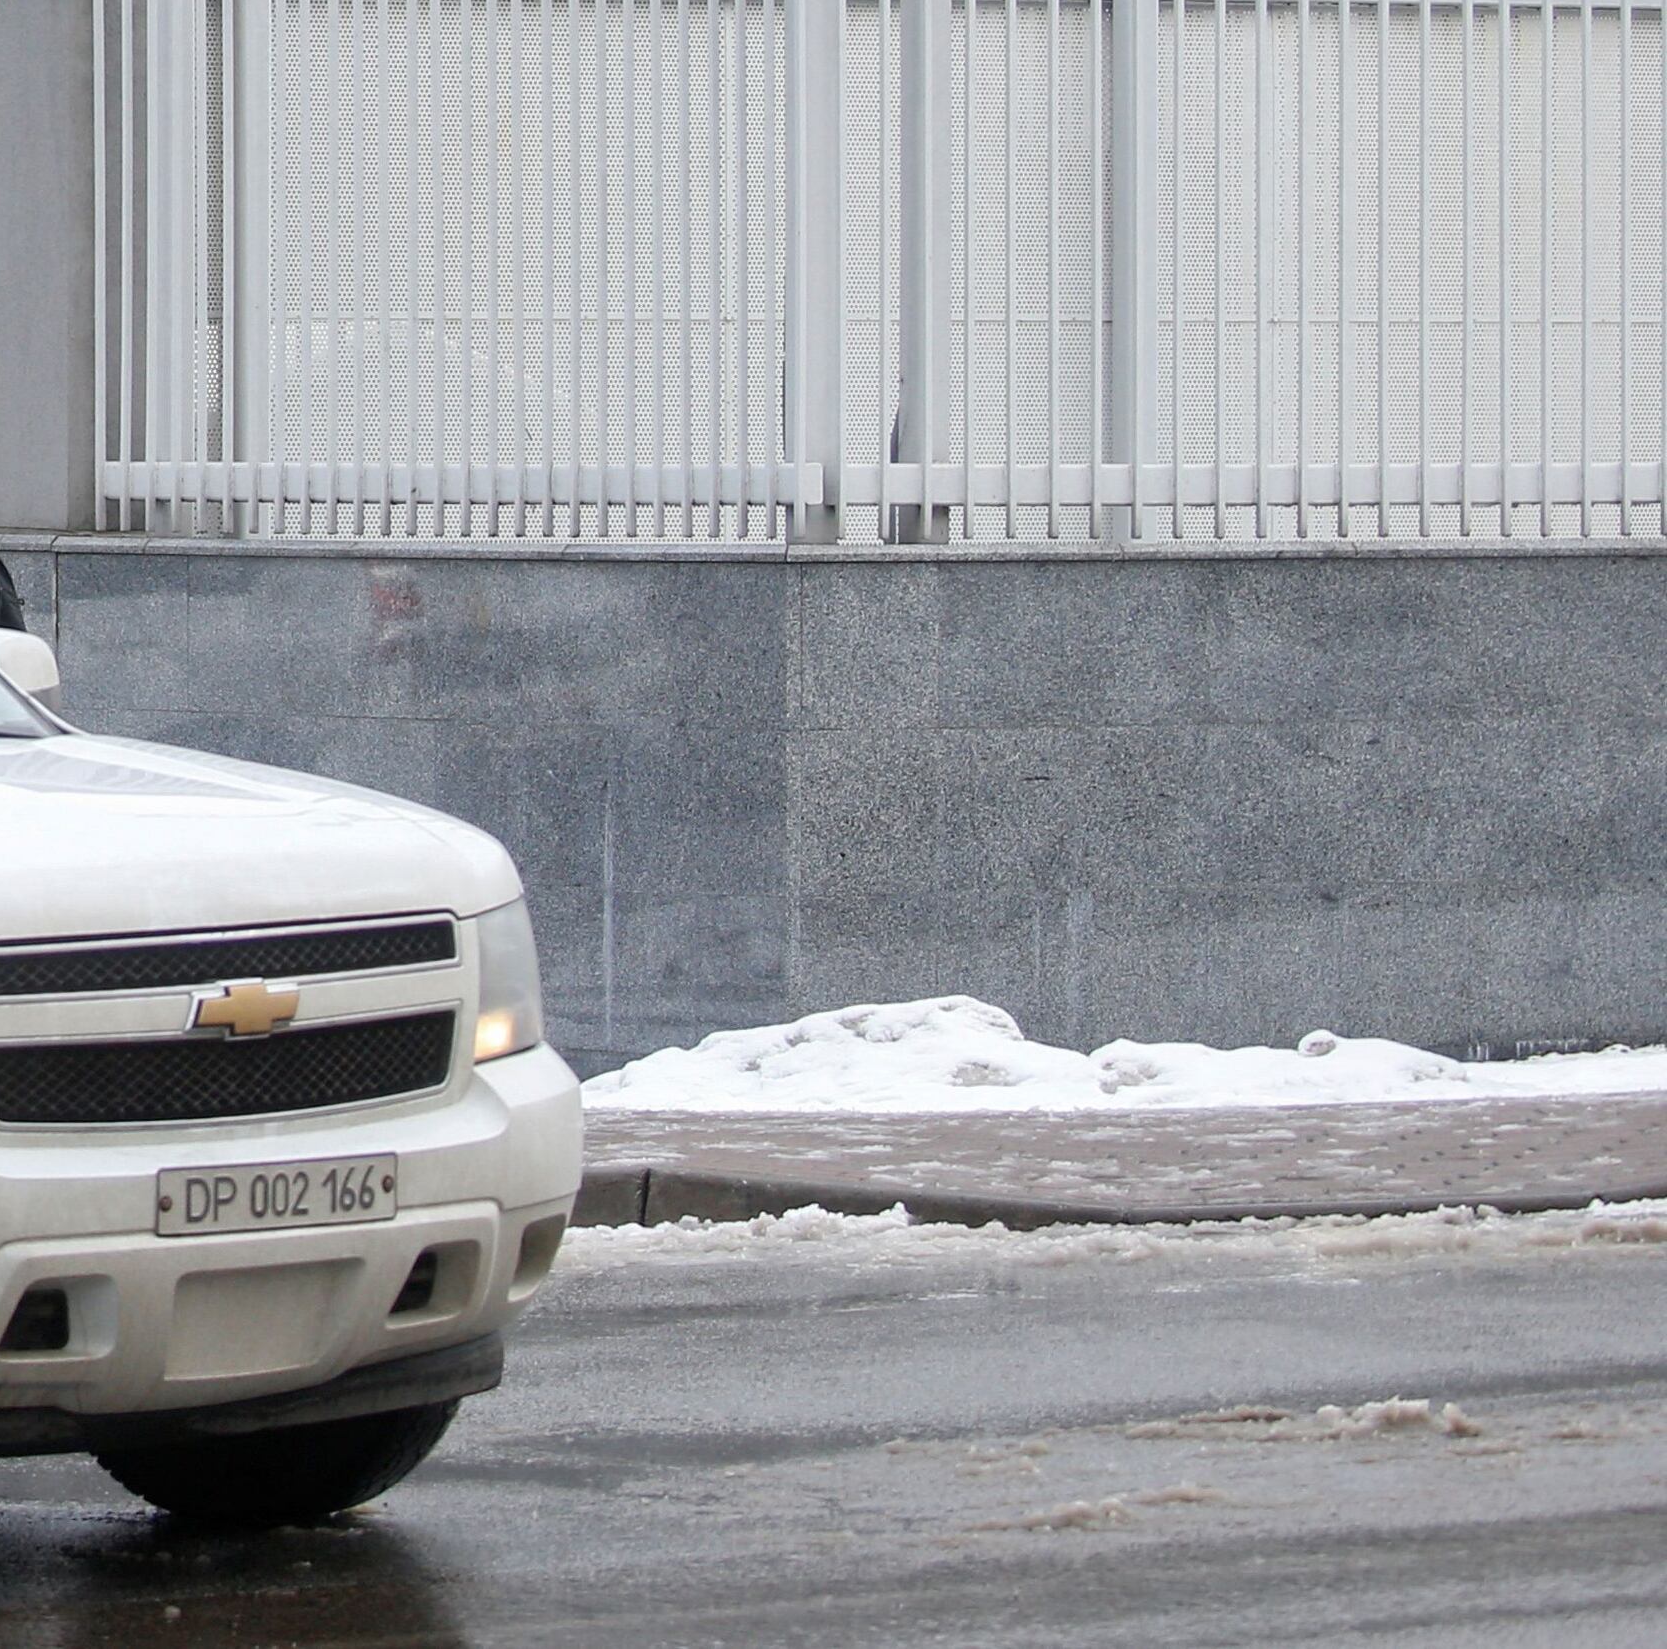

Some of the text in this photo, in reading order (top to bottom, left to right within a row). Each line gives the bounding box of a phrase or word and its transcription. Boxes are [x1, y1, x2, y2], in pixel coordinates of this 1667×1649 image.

[185, 1165, 375, 1223] DP 002 166
